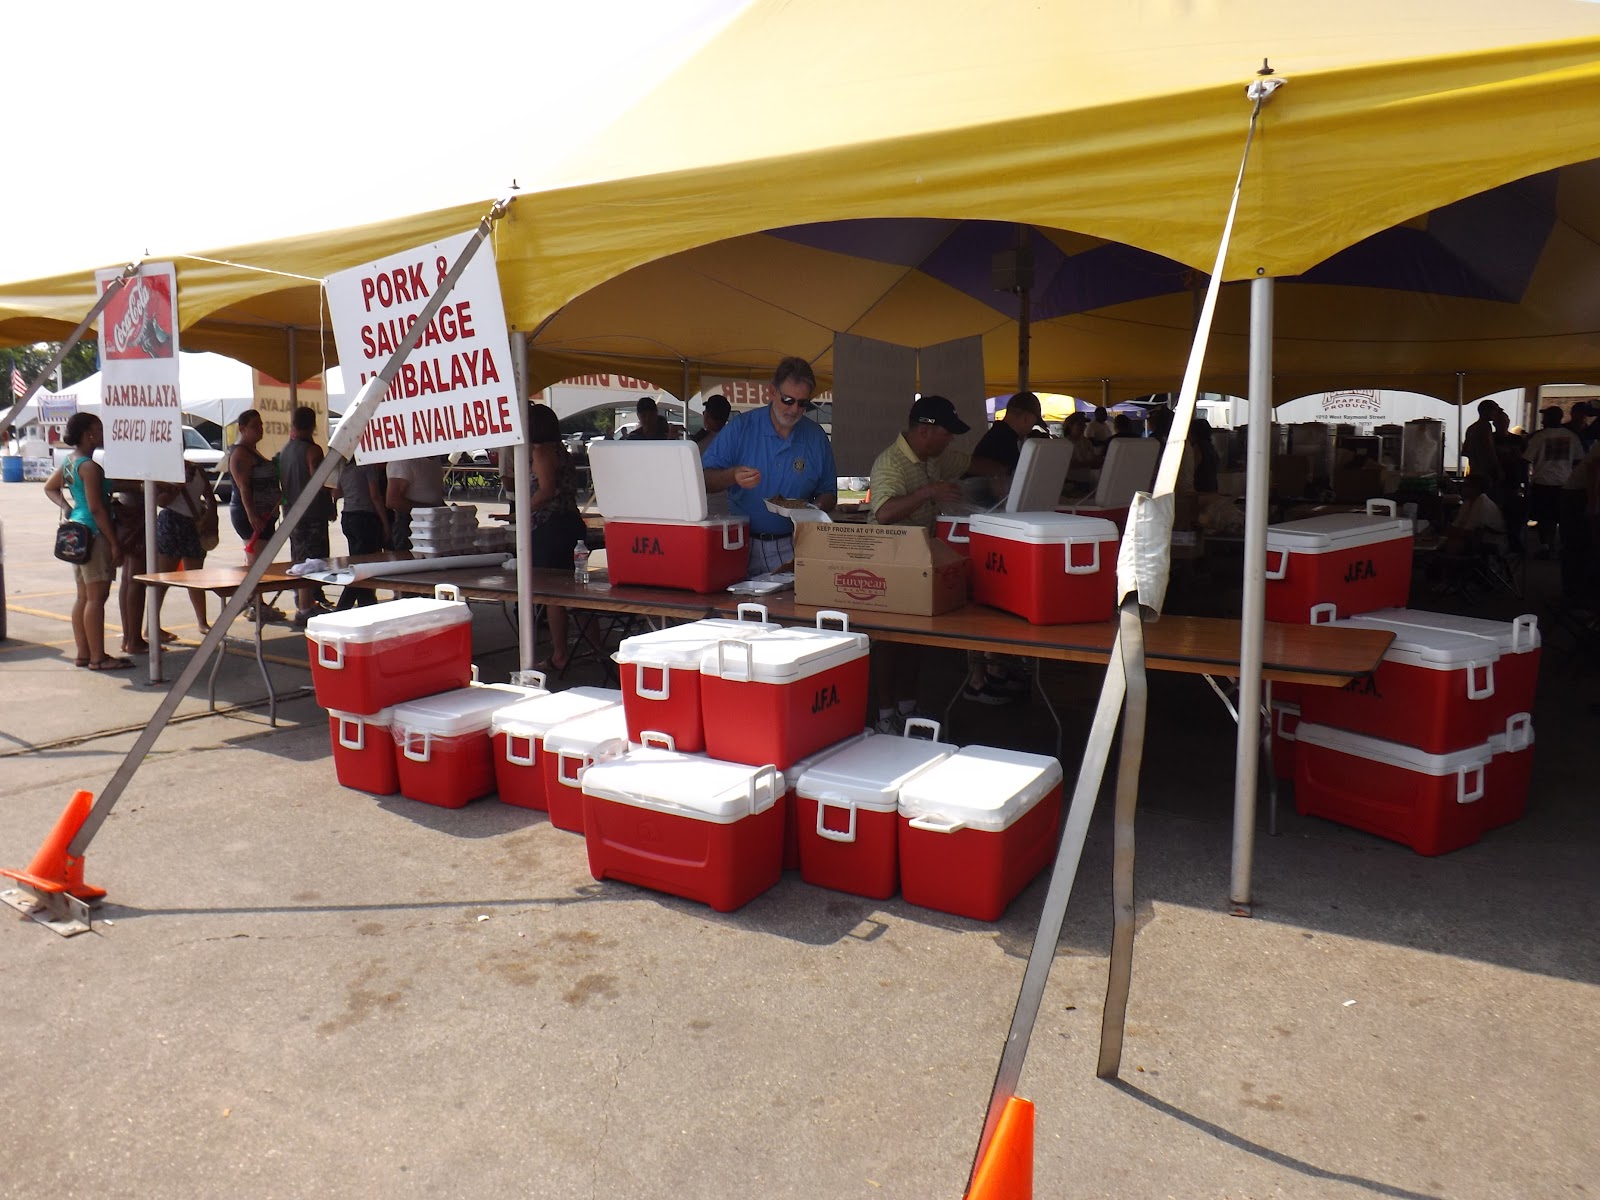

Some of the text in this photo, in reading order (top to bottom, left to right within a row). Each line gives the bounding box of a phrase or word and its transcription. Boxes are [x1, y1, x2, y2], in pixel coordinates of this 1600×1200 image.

[361, 255, 456, 313] PORK &
[360, 301, 475, 360] SAUSAGE
[360, 347, 500, 403] MBALAYA
[104, 384, 179, 408] JAMBALAYA
[1324, 403, 1379, 413] PRODUCTS
[112, 419, 173, 443] SERVED HERE
[359, 396, 513, 454] WHEN AVAILABLE
[832, 526, 855, 534] FROZEN
[631, 536, 665, 556] J.F.A.
[834, 573, 888, 590] European
[811, 683, 841, 714] J.F.A.
